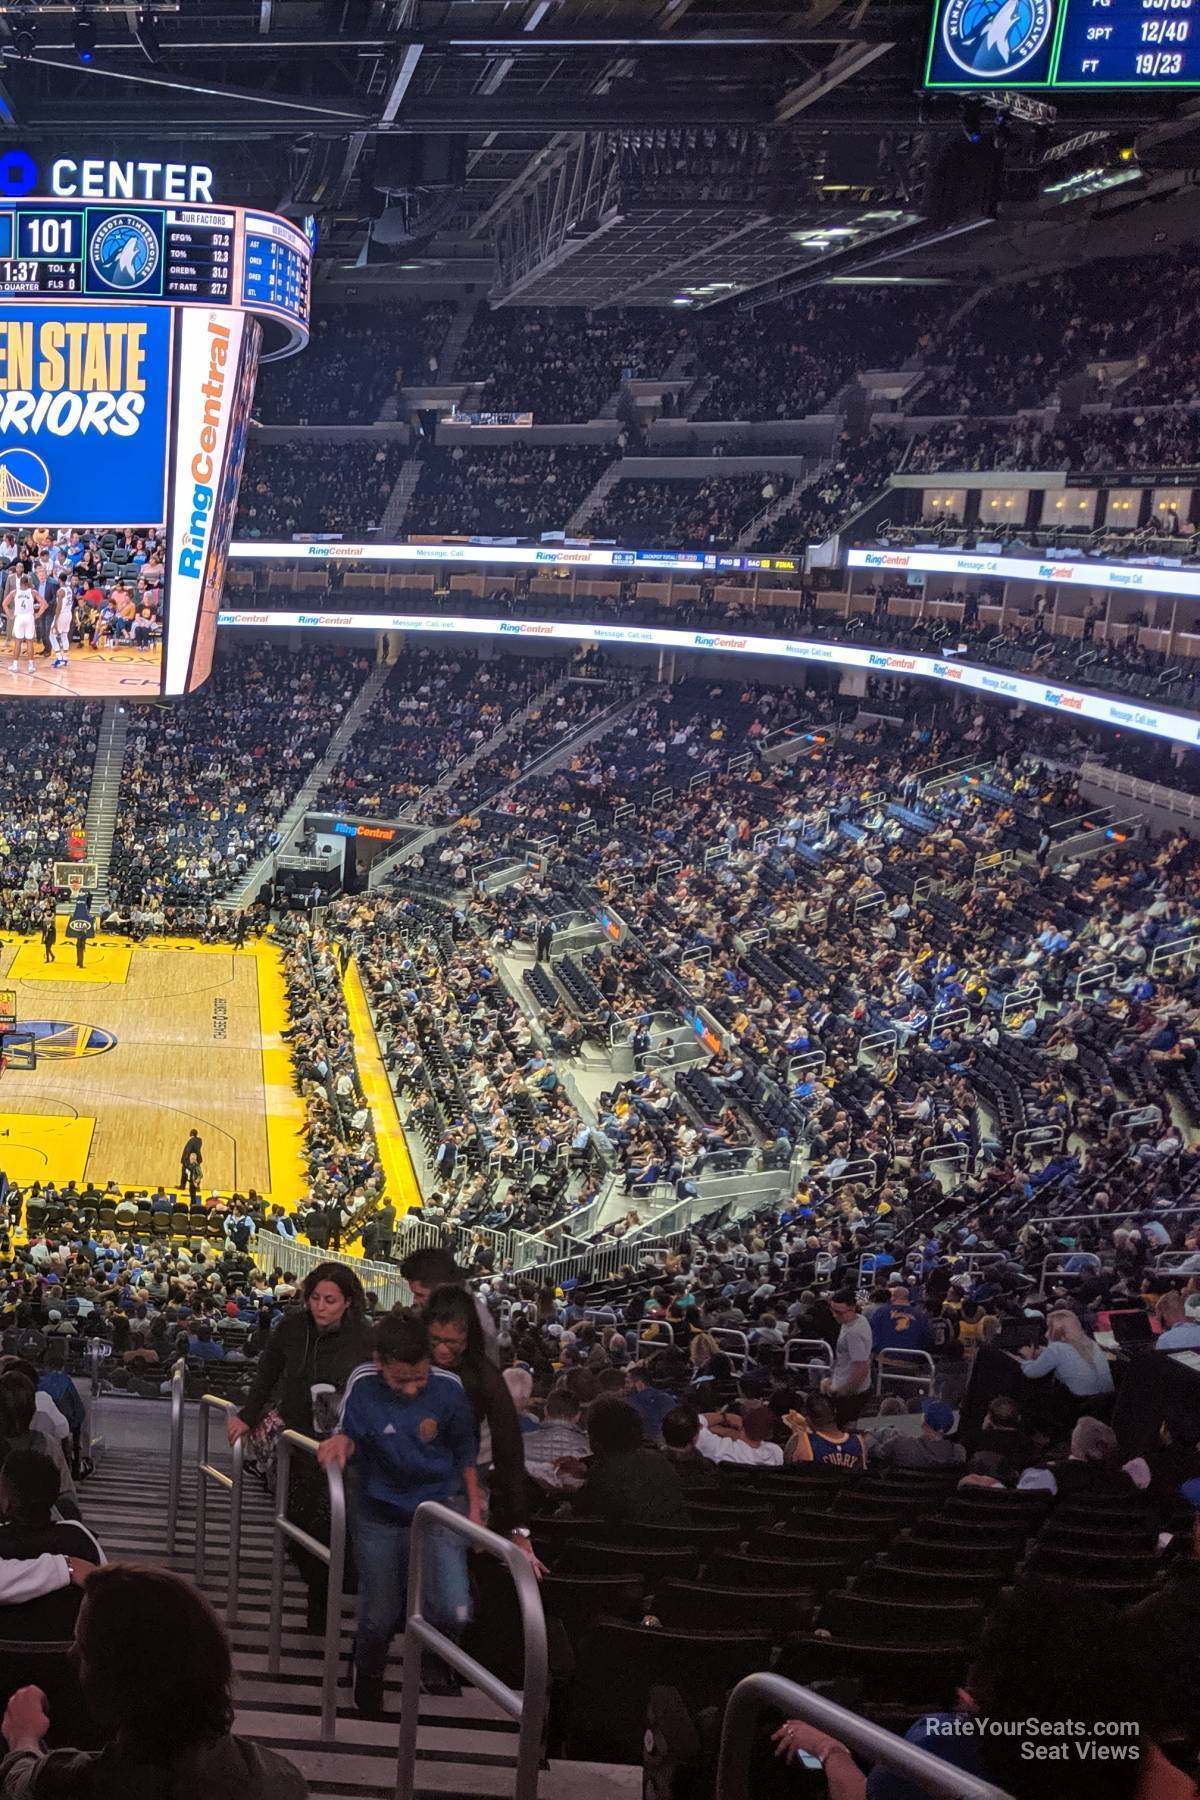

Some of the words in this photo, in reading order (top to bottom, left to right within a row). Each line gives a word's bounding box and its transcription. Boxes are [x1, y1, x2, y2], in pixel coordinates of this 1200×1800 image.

[1086, 28, 1112, 40] 3PT
[1141, 21, 1188, 44] 12/40
[1082, 60, 1099, 72] FT
[1135, 54, 1181, 77] 19/23
[52, 159, 213, 202] CENTER
[181, 213, 196, 224] OUR
[196, 214, 226, 226] FACTORS
[28, 219, 72, 253] 101
[212, 234, 230, 247] 57.2
[94, 219, 123, 261] MINNESOTA
[126, 218, 156, 277] TIMBERWOLVES
[213, 251, 228, 263] 12.3
[49, 264, 65, 273] TOL
[69, 262, 75, 273] 4
[212, 267, 228, 279] 31.0
[4, 283, 39, 291] QUARTER
[48, 280, 64, 289] FLS
[69, 280, 75, 290] 0
[169, 282, 179, 291] FT
[179, 283, 197, 292] RATE
[211, 283, 227, 295] 27.7
[39, 321, 148, 392] STATE
[177, 321, 231, 582] RingCentral
[309, 546, 363, 556] RingCentral
[535, 551, 591, 562] RingCentral
[865, 553, 910, 566] RingCentral
[298, 615, 352, 625] RingCentral
[499, 622, 554, 634] RingCentral
[694, 635, 748, 649] RingCentral
[868, 654, 916, 670] RingCentral
[335, 822, 394, 840] RingCentral
[73, 921, 88, 930] KIA
[213, 1021, 227, 1039] CHASE
